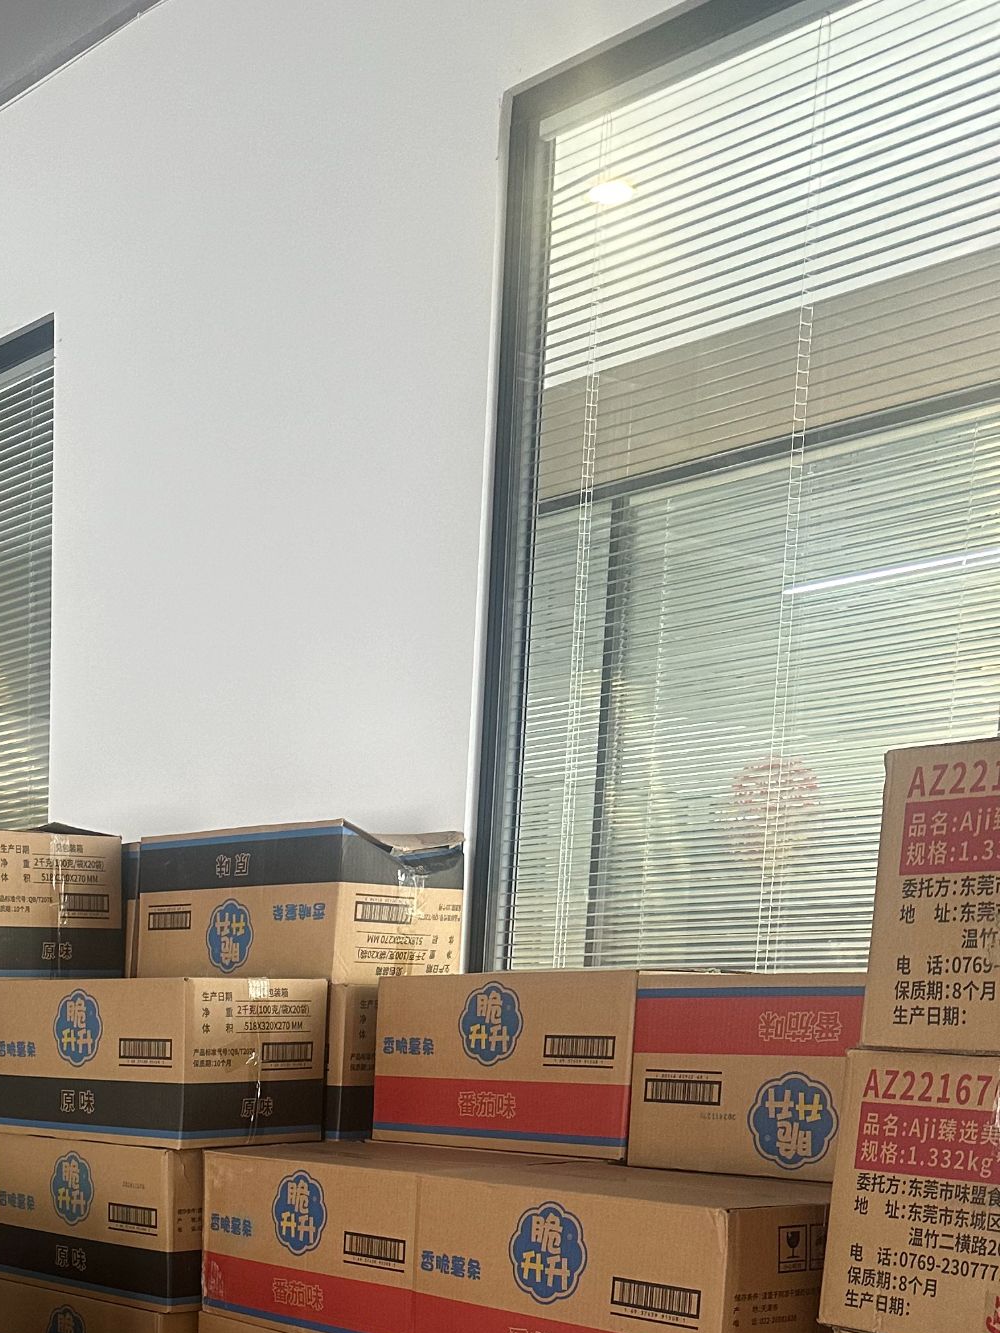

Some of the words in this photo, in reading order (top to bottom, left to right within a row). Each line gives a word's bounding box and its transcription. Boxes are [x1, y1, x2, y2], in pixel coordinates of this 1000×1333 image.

[908, 759, 1000, 798] AZ221
[42, 942, 72, 960] 原味
[894, 979, 996, 1002] 保质期:8个月
[759, 1010, 842, 1042] 番茄味
[893, 1005, 968, 1026] 生产日期:
[382, 1037, 434, 1056] 香脆薯条
[60, 1089, 95, 1114] 原味
[458, 1092, 516, 1118] 番茄味
[420, 1250, 481, 1281] 香脆薯条
[272, 1277, 324, 1312] 番茄味
[847, 1266, 937, 1297] 保质期:8个月
[844, 1289, 910, 1316] 生产日期:
